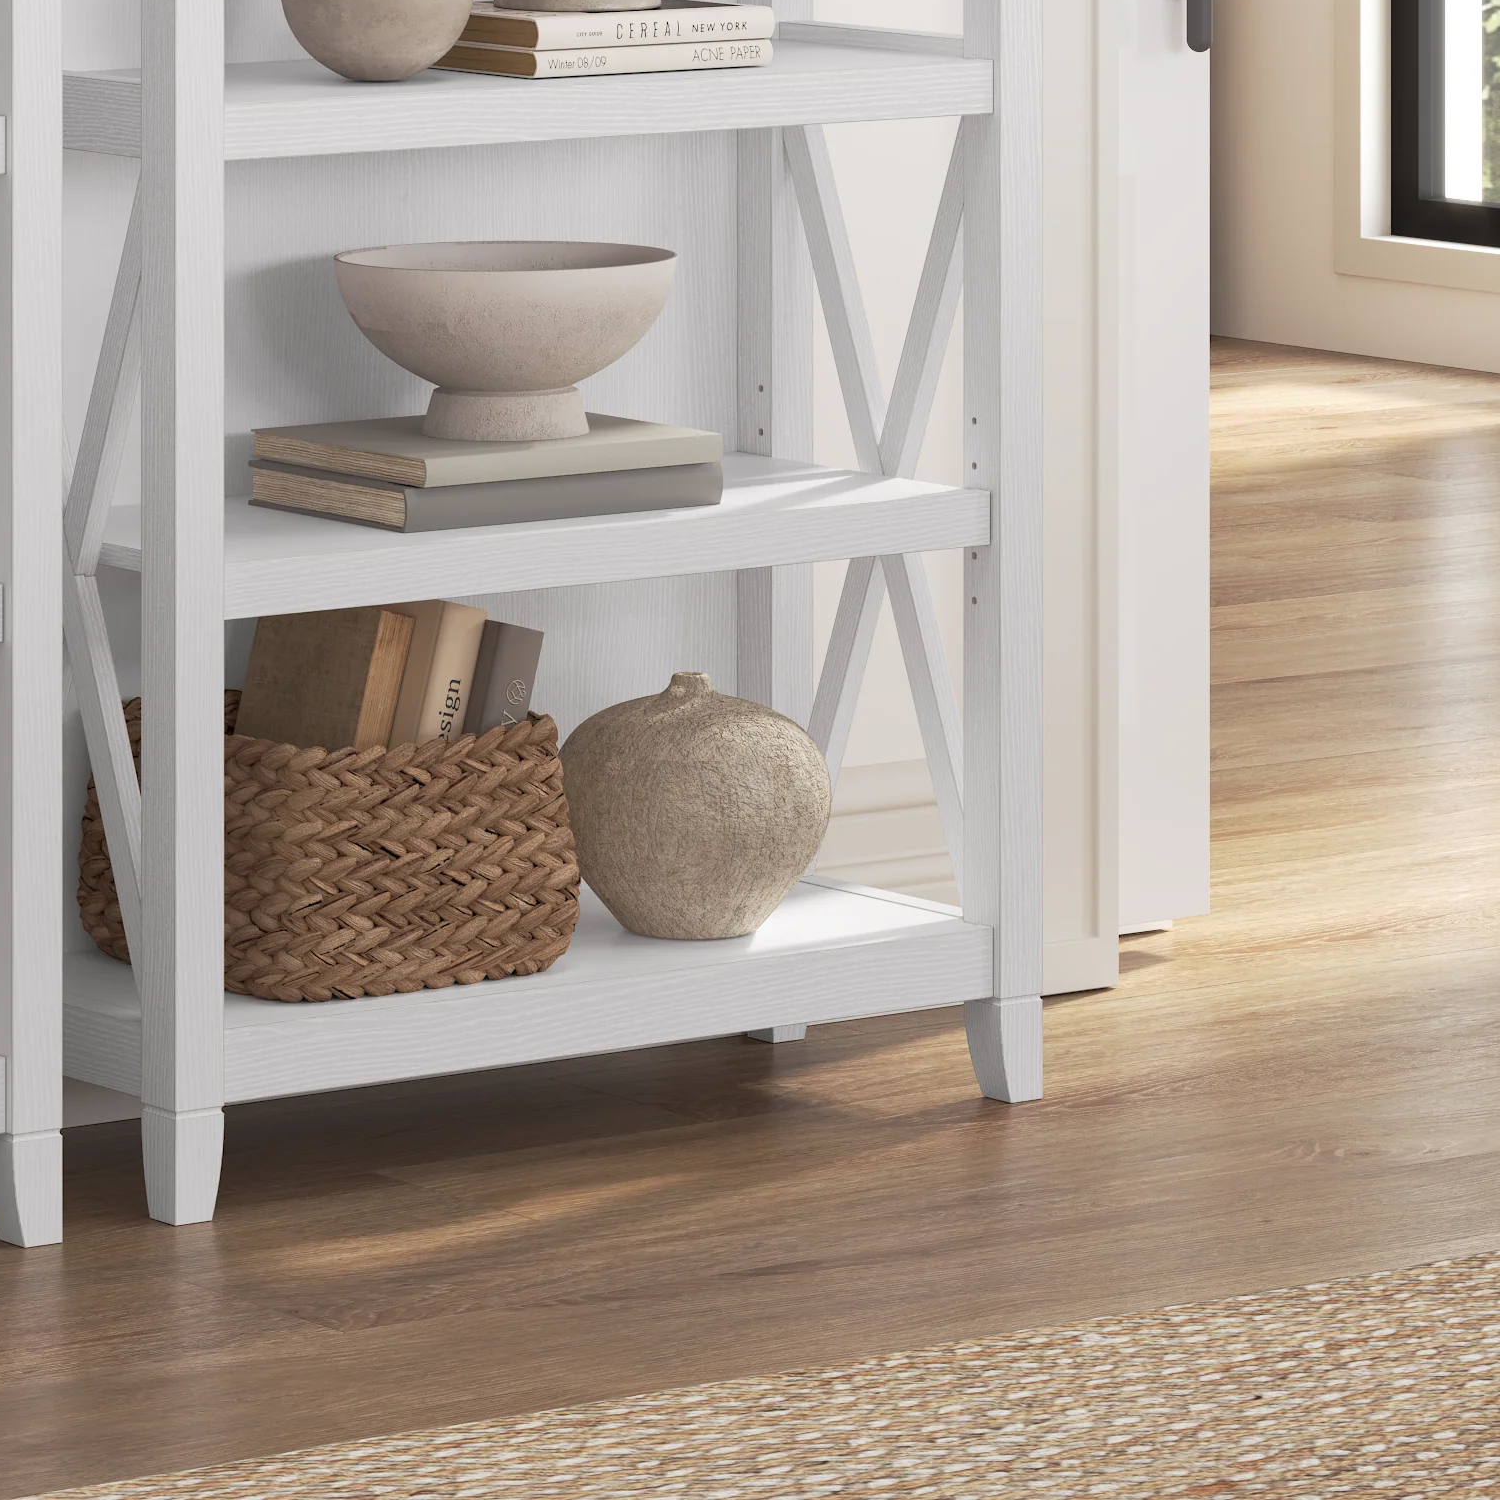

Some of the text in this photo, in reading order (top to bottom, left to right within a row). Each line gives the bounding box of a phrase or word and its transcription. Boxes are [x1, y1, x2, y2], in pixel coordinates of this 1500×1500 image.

[616, 20, 682, 40] CEREAL
[691, 24, 715, 34] NEW
[719, 21, 748, 33] YORK
[547, 55, 607, 70] Winter 08/09
[692, 45, 761, 63] ACNE PAPER
